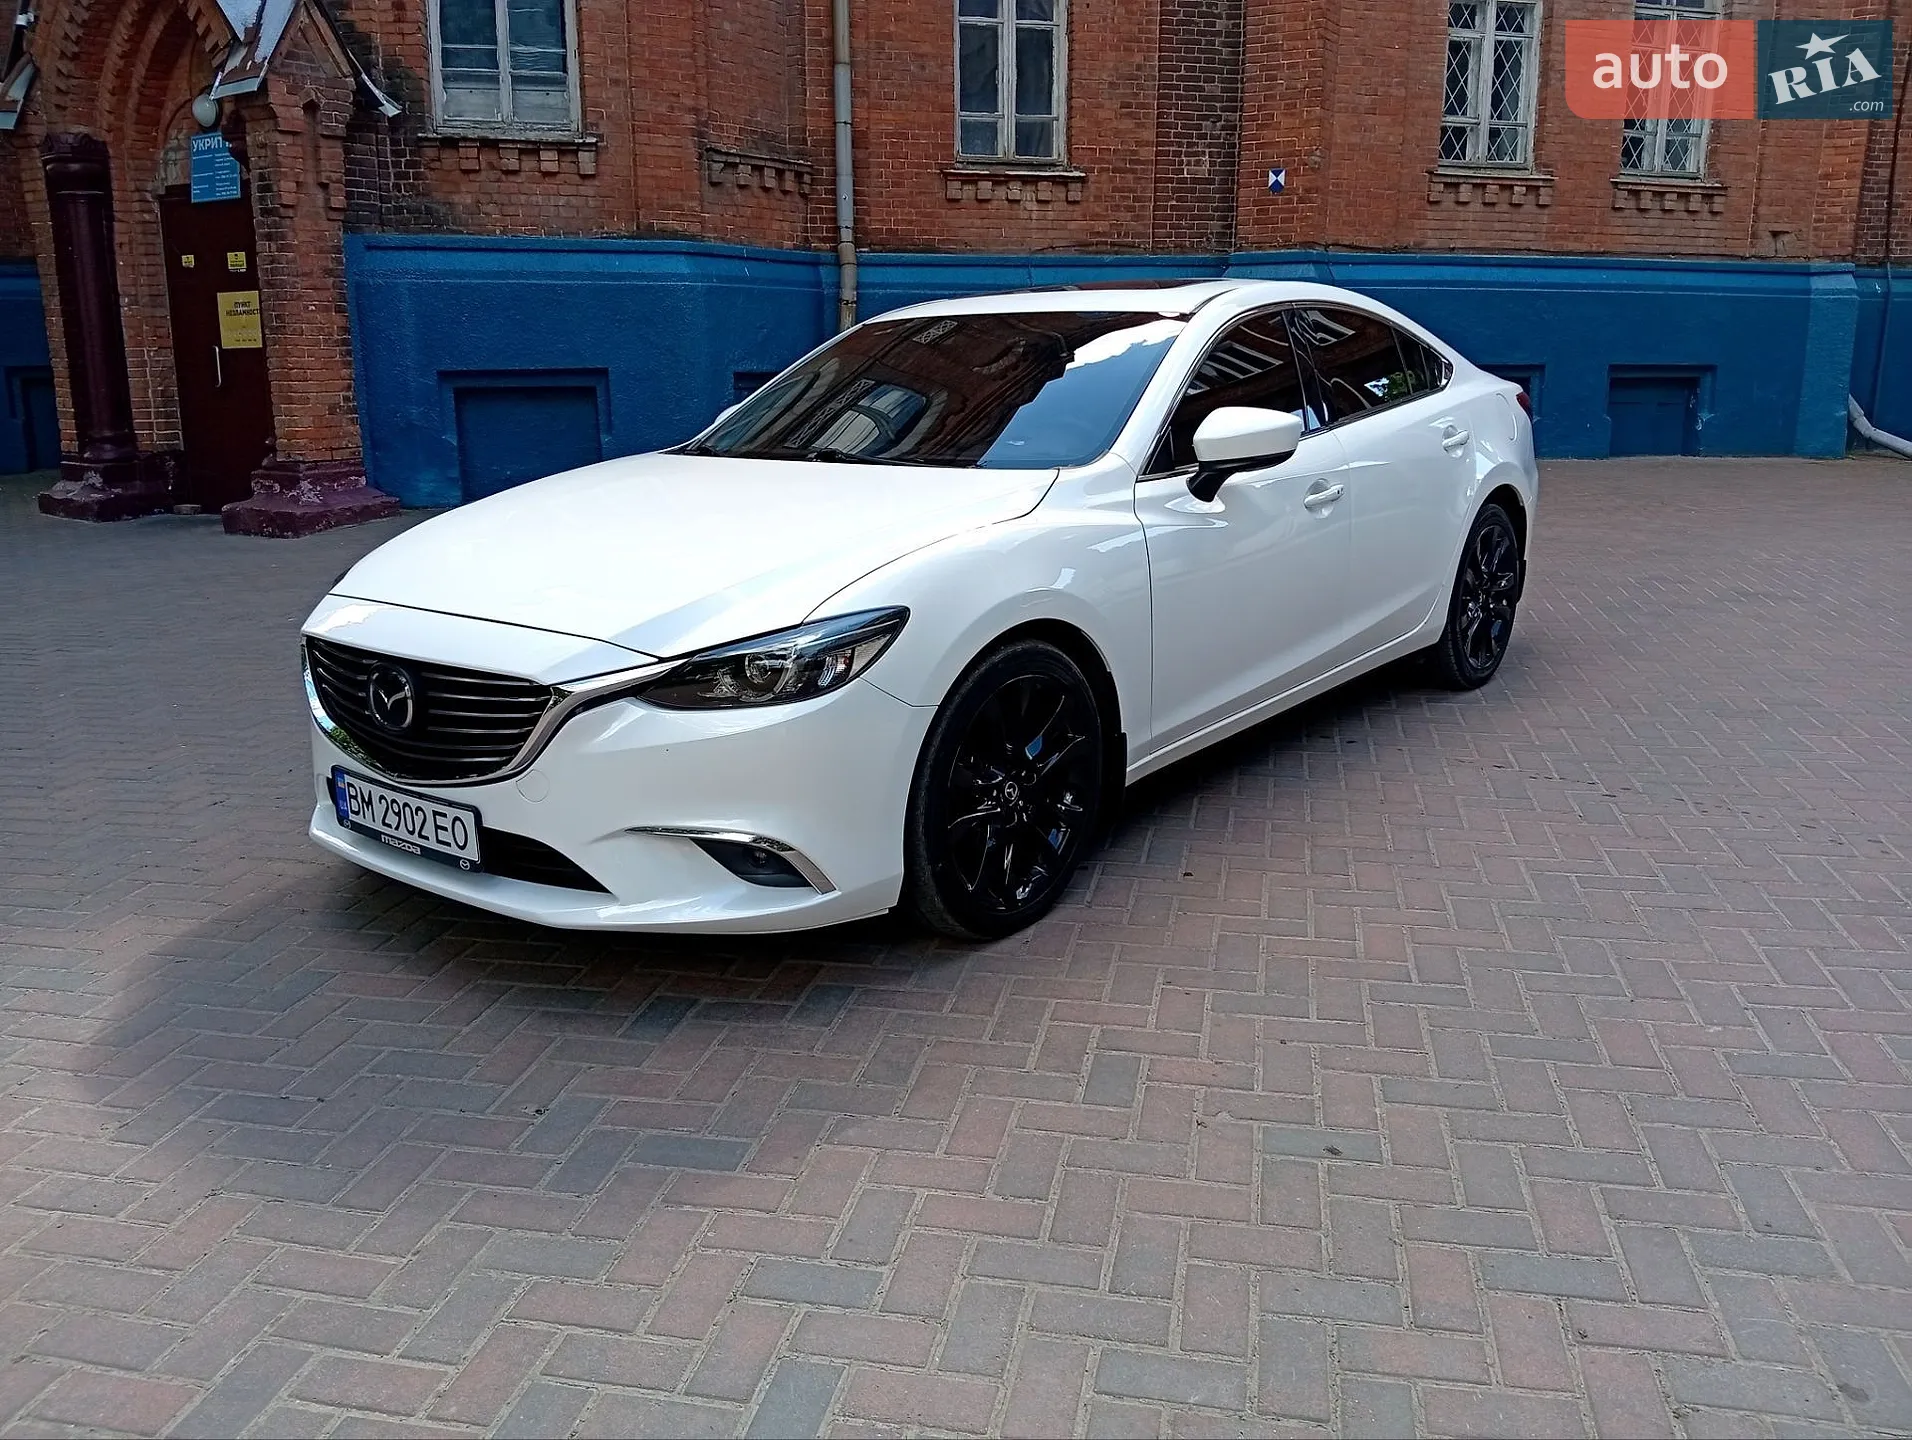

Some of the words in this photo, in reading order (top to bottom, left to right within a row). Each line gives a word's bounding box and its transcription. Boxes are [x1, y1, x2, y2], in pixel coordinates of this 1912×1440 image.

[192, 136, 233, 152] УКРИТ
[346, 781, 376, 823] BM
[378, 794, 430, 842] 2902
[432, 808, 469, 851] EO
[380, 834, 421, 855] mazda
